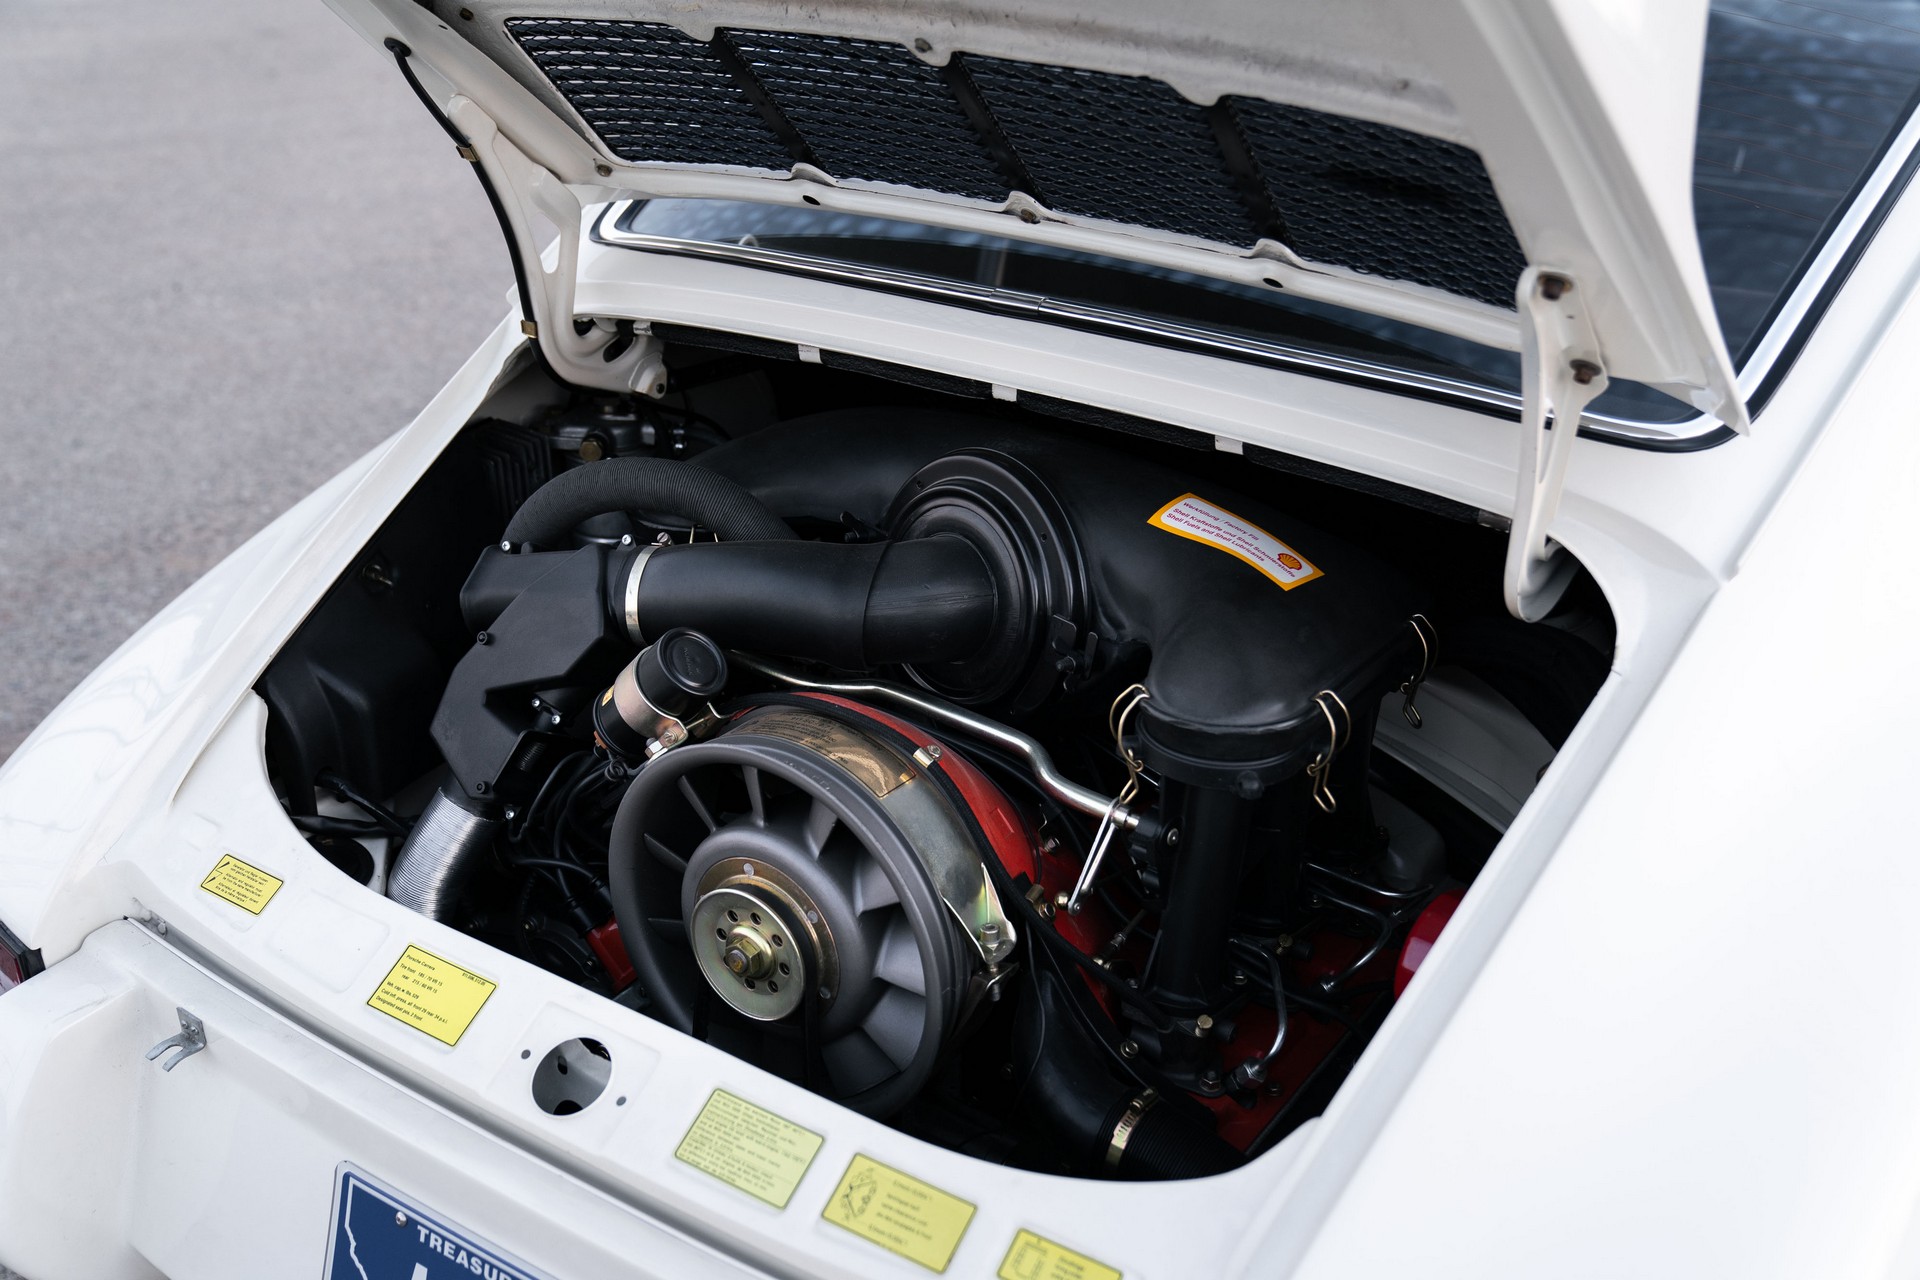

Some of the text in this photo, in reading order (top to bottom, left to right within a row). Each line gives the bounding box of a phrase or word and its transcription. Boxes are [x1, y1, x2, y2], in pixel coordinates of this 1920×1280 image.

[1167, 513, 1184, 523] Shell
[1184, 520, 1200, 530] Fuels
[1214, 533, 1231, 543] Shell
[1232, 540, 1264, 561] Lubricants
[1183, 502, 1220, 521] Werkfüllung
[1224, 521, 1248, 534] Factory
[1248, 533, 1259, 541] Fill
[1173, 508, 1296, 577] Shell Kraftstoffe und Shell Schmierstoffe
[405, 954, 435, 970] Porsche Carrera
[406, 966, 416, 974] front
[374, 995, 395, 1008] Designated
[412, 1013, 423, 1021] front
